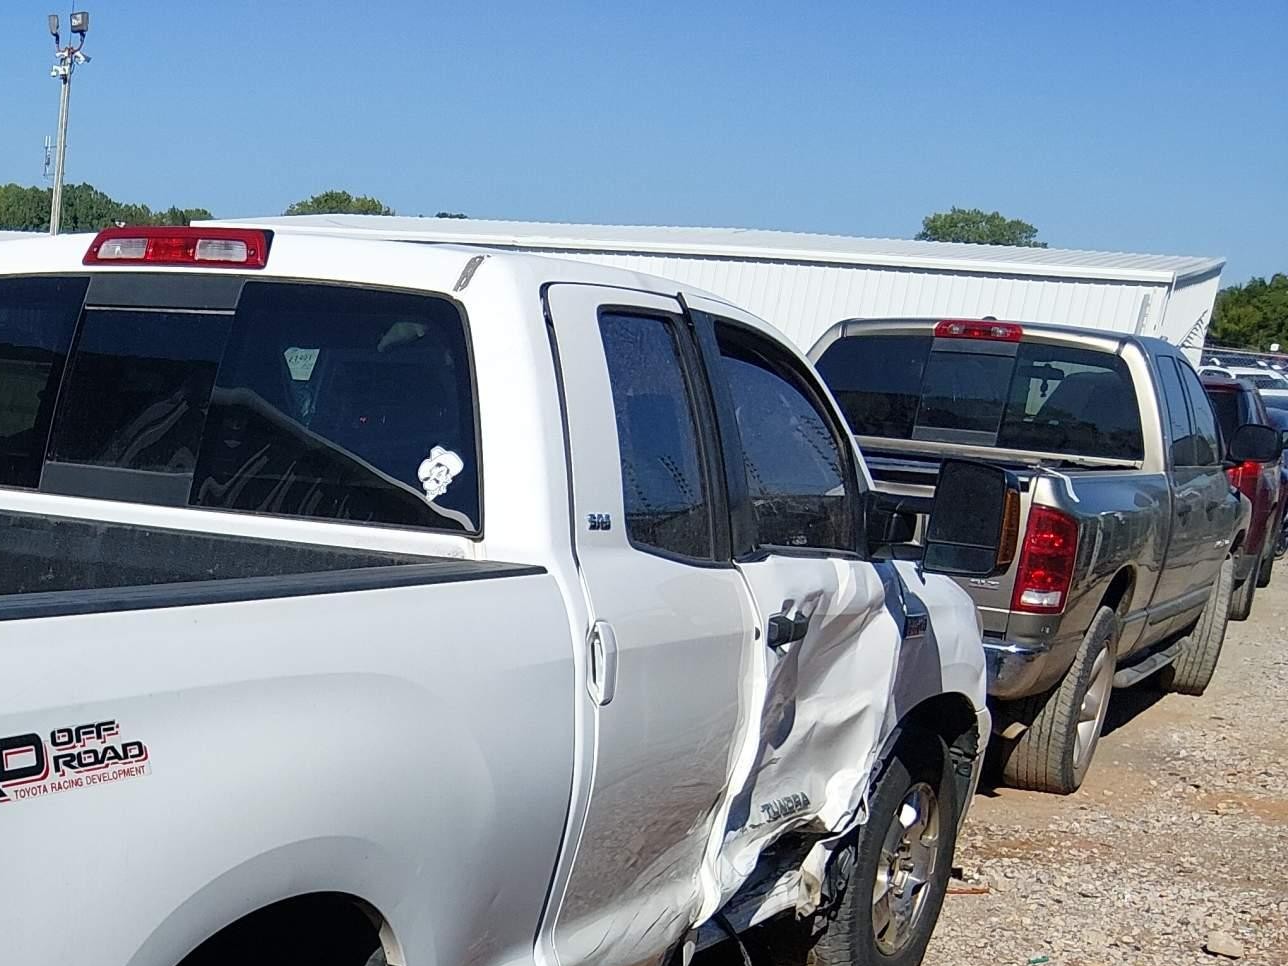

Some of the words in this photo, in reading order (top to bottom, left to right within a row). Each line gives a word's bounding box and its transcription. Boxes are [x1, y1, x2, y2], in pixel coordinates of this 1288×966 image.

[50, 720, 119, 751] OFF
[53, 740, 148, 776] ROAD
[13, 786, 49, 800] TOYOTA
[50, 778, 84, 792] RACING
[85, 766, 146, 787] DEVELOPMENT
[760, 791, 810, 821] TUNDRA
